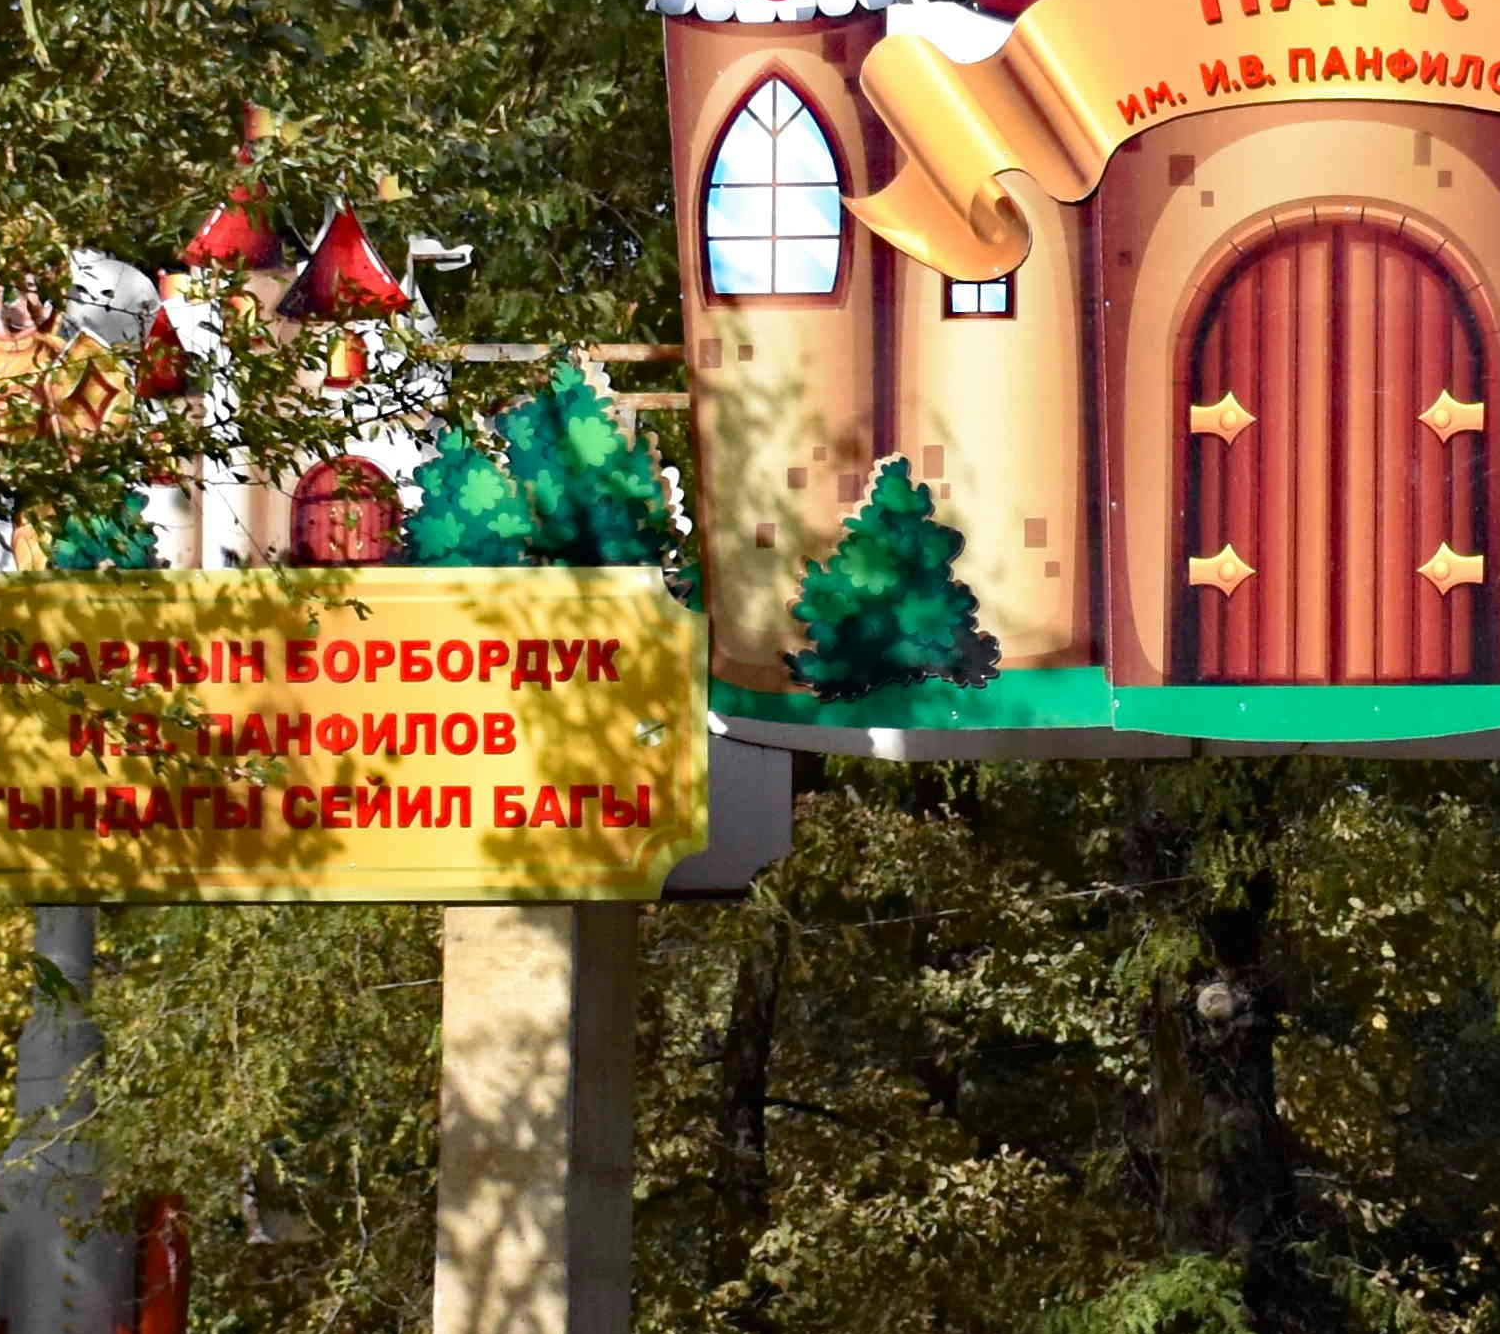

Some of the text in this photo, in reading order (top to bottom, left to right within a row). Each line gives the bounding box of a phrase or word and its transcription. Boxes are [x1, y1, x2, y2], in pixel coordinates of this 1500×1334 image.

[1116, 81, 1187, 125] ИМ.
[1199, 54, 1277, 96] И.В.
[284, 638, 622, 691] БОРБОРДУК
[196, 712, 518, 757] ПАНФИЛОВ
[281, 775, 473, 830] СЕЙИЛ
[494, 783, 653, 829] БАГЫ
